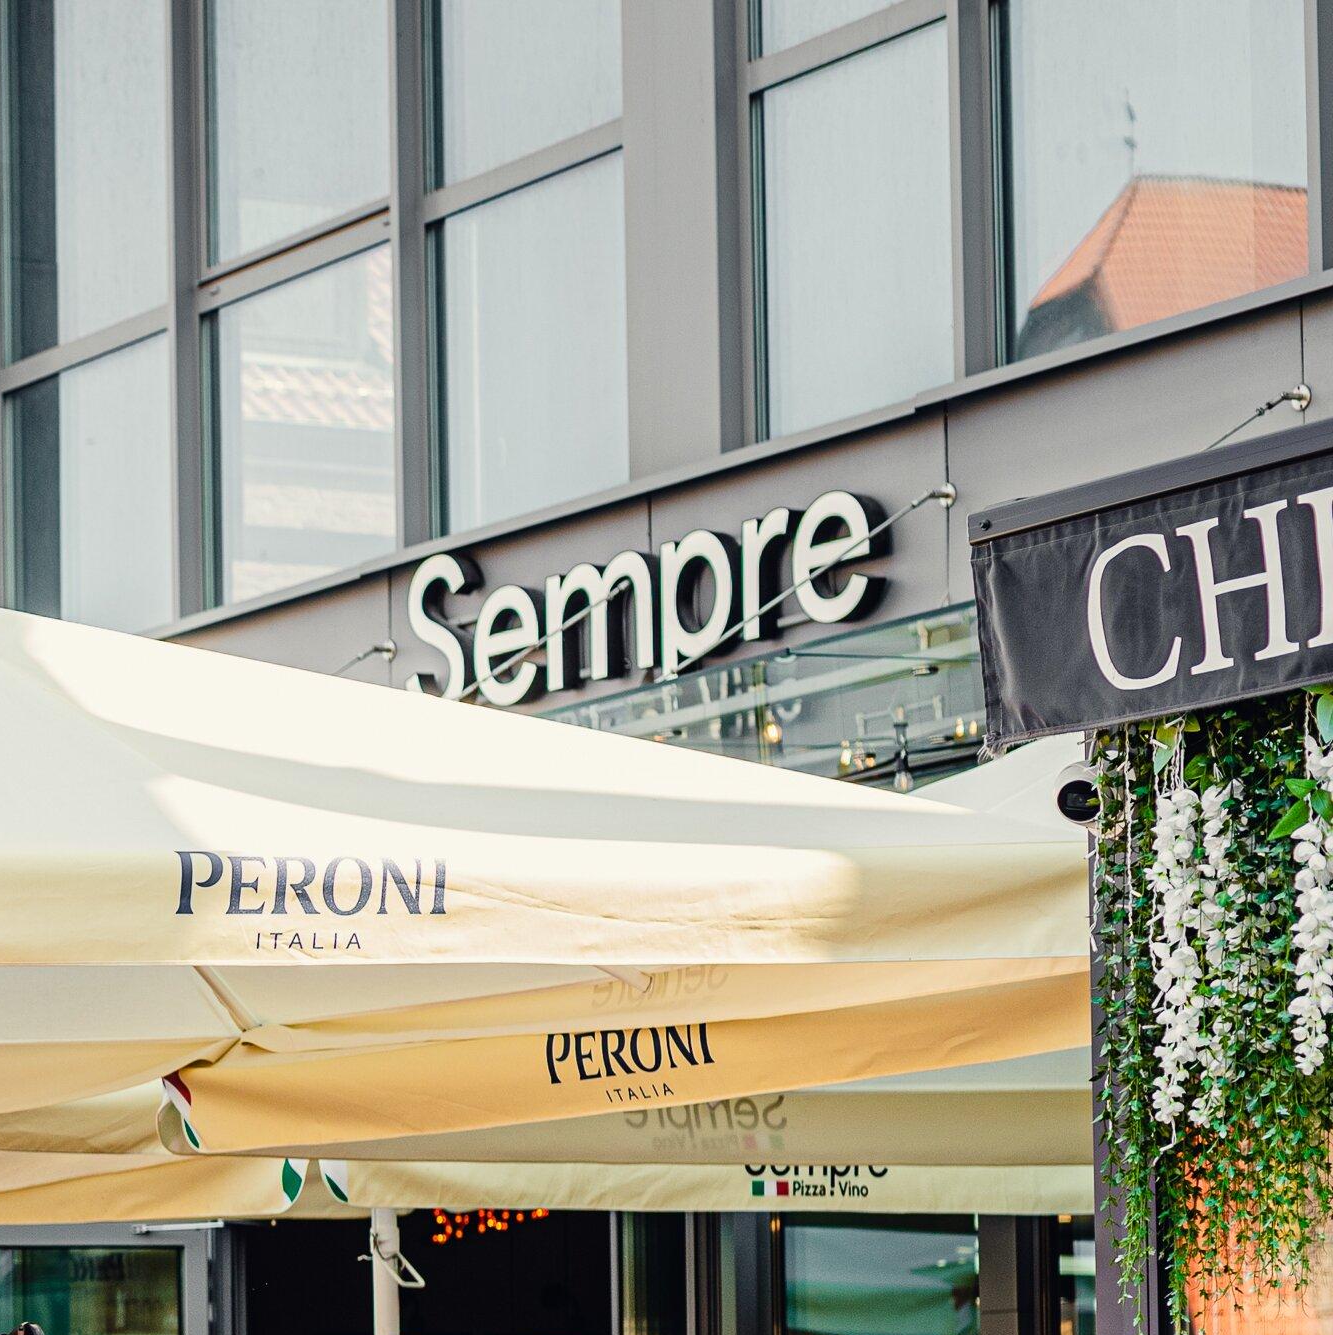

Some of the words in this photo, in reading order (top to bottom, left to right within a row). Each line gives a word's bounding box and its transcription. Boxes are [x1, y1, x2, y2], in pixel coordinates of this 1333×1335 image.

[406, 490, 871, 706] Sempre
[174, 850, 447, 916] PERONI
[255, 932, 362, 950] ITALIA
[545, 1022, 715, 1085] PERONI
[605, 1082, 675, 1103] ITALIA
[792, 1180, 827, 1197] Pizza
[838, 1180, 869, 1198] Vino
